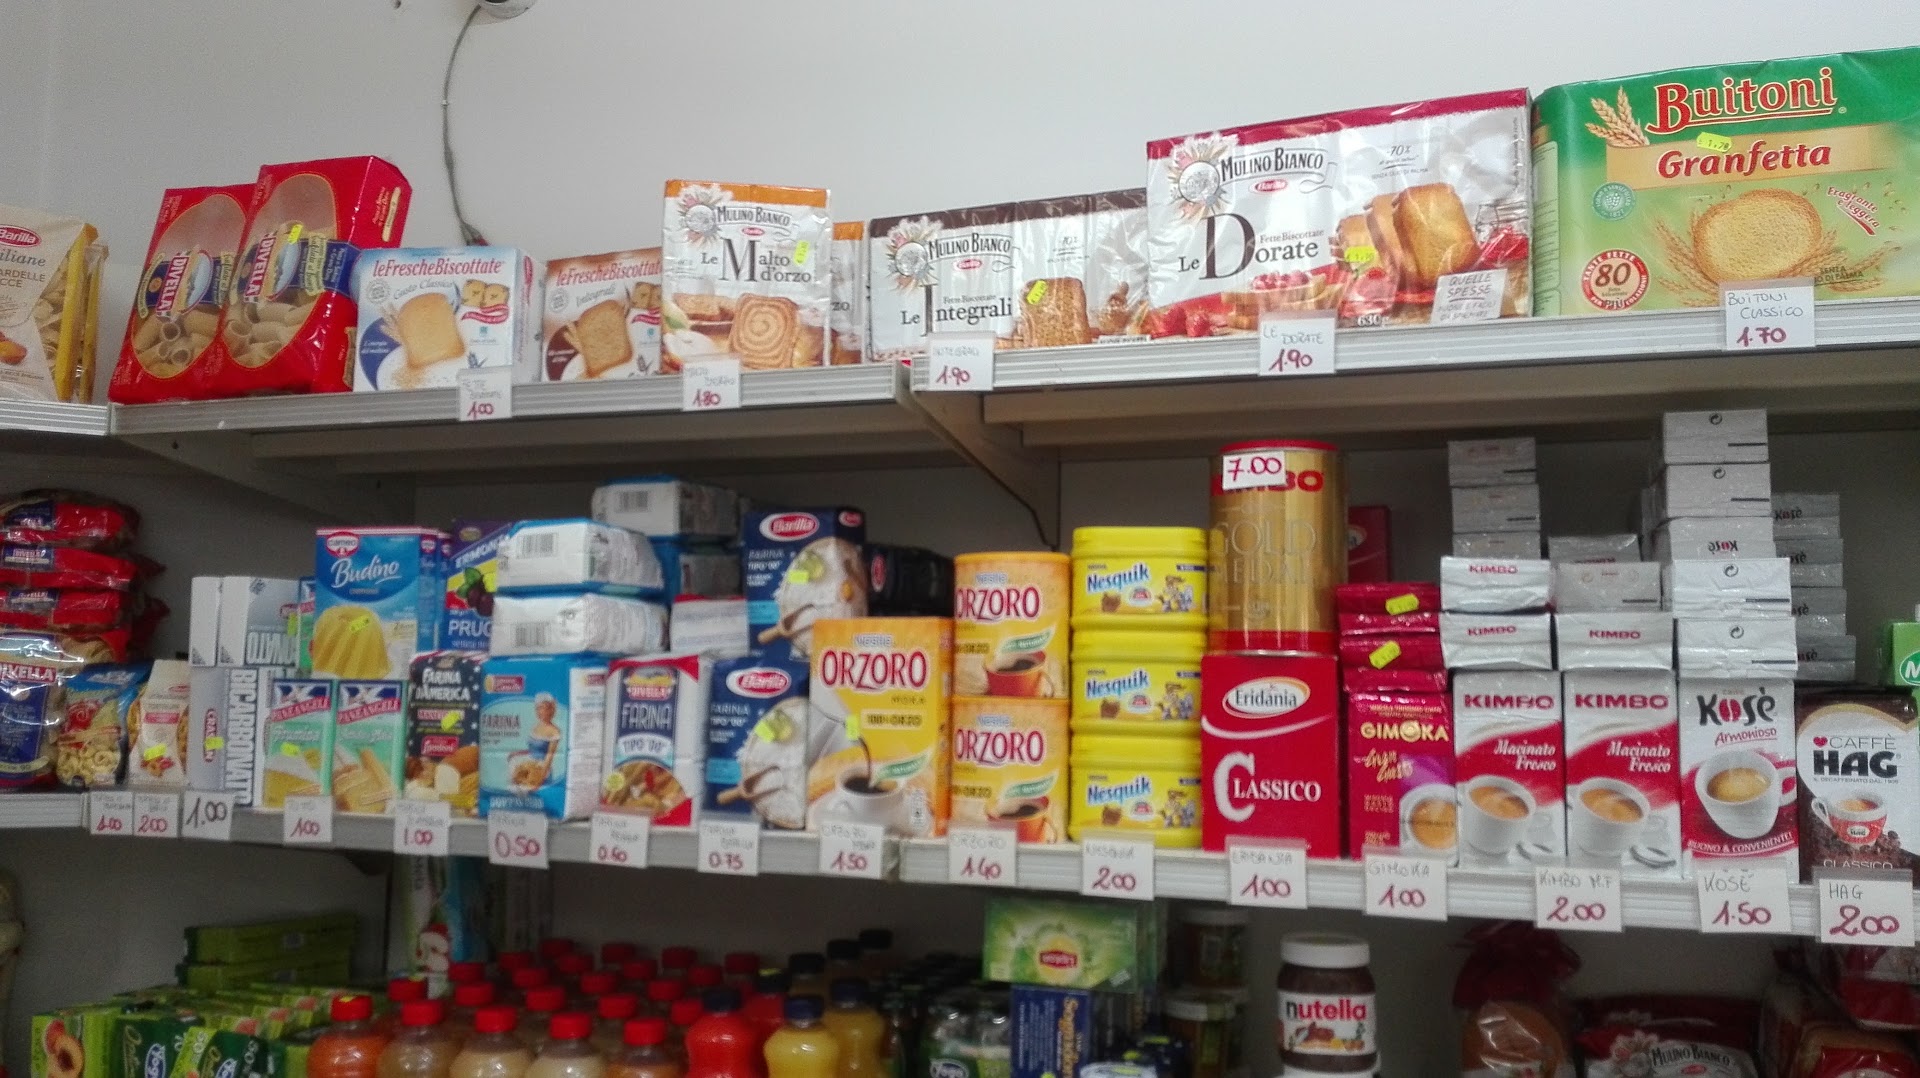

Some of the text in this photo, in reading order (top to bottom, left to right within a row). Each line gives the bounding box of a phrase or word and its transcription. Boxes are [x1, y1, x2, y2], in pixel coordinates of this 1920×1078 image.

[1646, 68, 1837, 134] Buitoni
[1222, 148, 1324, 182] MULINO BIANCO
[1657, 141, 1831, 179] Granfetta
[1829, 187, 1878, 212] Fragrante
[716, 206, 791, 227] MULINO BIANCO
[1846, 201, 1880, 227] leggera
[928, 232, 1011, 258] MULINO BIANCO
[0, 248, 46, 267] iliane
[245, 237, 276, 297] DIVELLA
[700, 252, 719, 265] Le
[1178, 256, 1200, 273] Le
[0, 268, 46, 283] ARDELLE
[158, 256, 189, 311] DIVELLA
[760, 266, 812, 283] d'orzo
[1449, 272, 1492, 287] QUELLE
[1595, 262, 1631, 287] 80
[1448, 285, 1491, 298] SPESSE
[901, 311, 920, 325] Le
[1735, 327, 1787, 347] 1.70
[1268, 349, 1312, 373] 1.90
[936, 365, 971, 386] 1.90
[1227, 457, 1282, 482] 7.00
[331, 554, 402, 588] Budino
[1086, 563, 1150, 592] Nesquik
[1468, 564, 1518, 575] KIMBO
[1467, 624, 1517, 637] KIMBO
[1589, 629, 1641, 640] KIMBO
[422, 667, 462, 685] FARINA
[822, 650, 927, 690] ORZORO
[1086, 670, 1150, 700] Nesquik
[1234, 688, 1298, 708] Eridania
[1464, 693, 1555, 709] KIMBO
[1575, 694, 1669, 709] KIMBO
[621, 703, 672, 731] FARINA
[1360, 720, 1449, 743] GIMOKA
[1714, 727, 1778, 746] Armonioso
[1829, 734, 1897, 750] CAFFÈ
[955, 728, 1044, 766] ORZORO
[1494, 740, 1556, 756] Macinato
[1607, 741, 1671, 758] Macinato
[1515, 756, 1557, 771] Fresco
[1629, 757, 1671, 773] Fresco
[1813, 750, 1898, 778] HAG
[1087, 776, 1151, 807] Nesquik
[1214, 751, 1321, 822] CLASSICO
[185, 797, 228, 829] 1.00
[1829, 883, 1863, 899] HAG
[1547, 896, 1606, 923] 2.00
[1712, 902, 1772, 926] 1.50
[1286, 998, 1367, 1021] nutella
